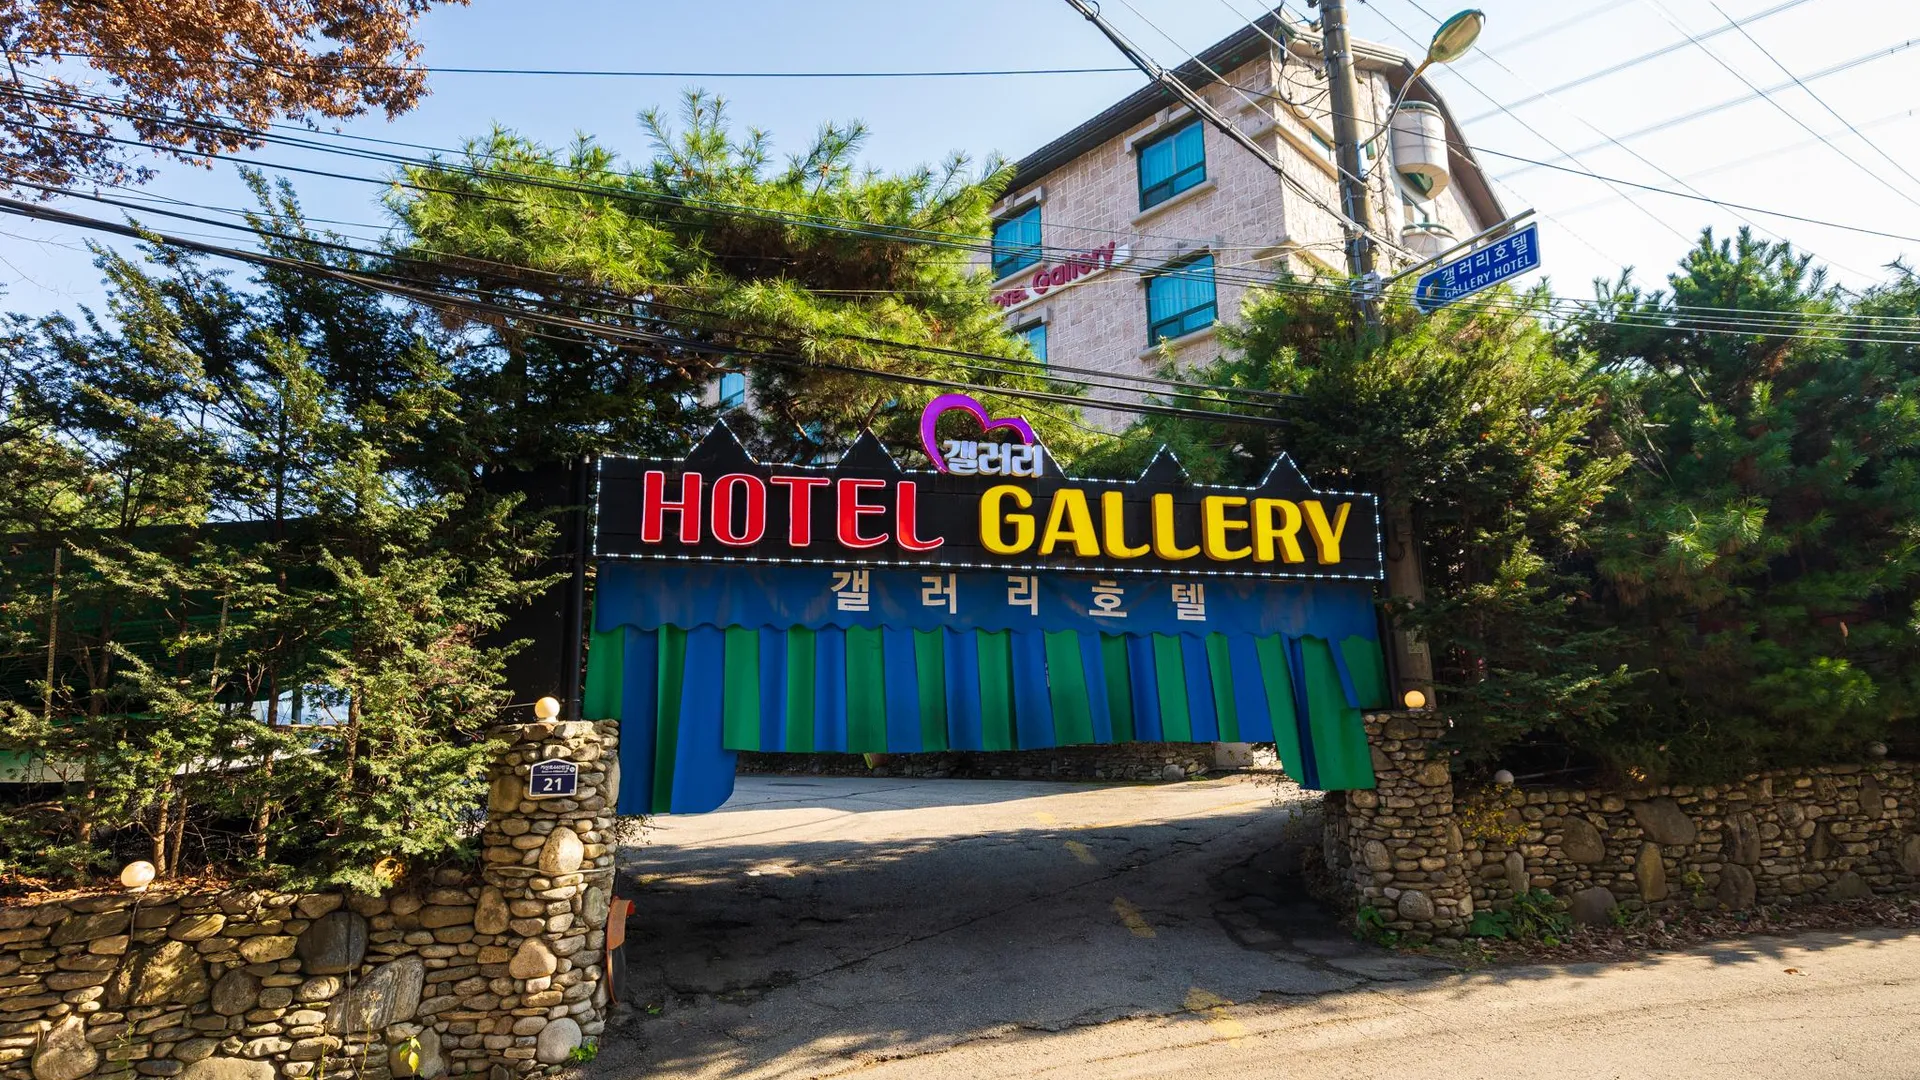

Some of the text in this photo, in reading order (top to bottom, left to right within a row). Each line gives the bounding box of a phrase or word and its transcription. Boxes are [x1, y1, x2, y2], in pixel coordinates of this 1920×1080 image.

[1442, 233, 1528, 286] 갤러리호텔
[1444, 255, 1531, 299] GALLERY HOTEL
[943, 439, 1044, 478] 갤러리
[641, 470, 1352, 565] HOTEL GALLERY
[543, 777, 562, 791] 21
